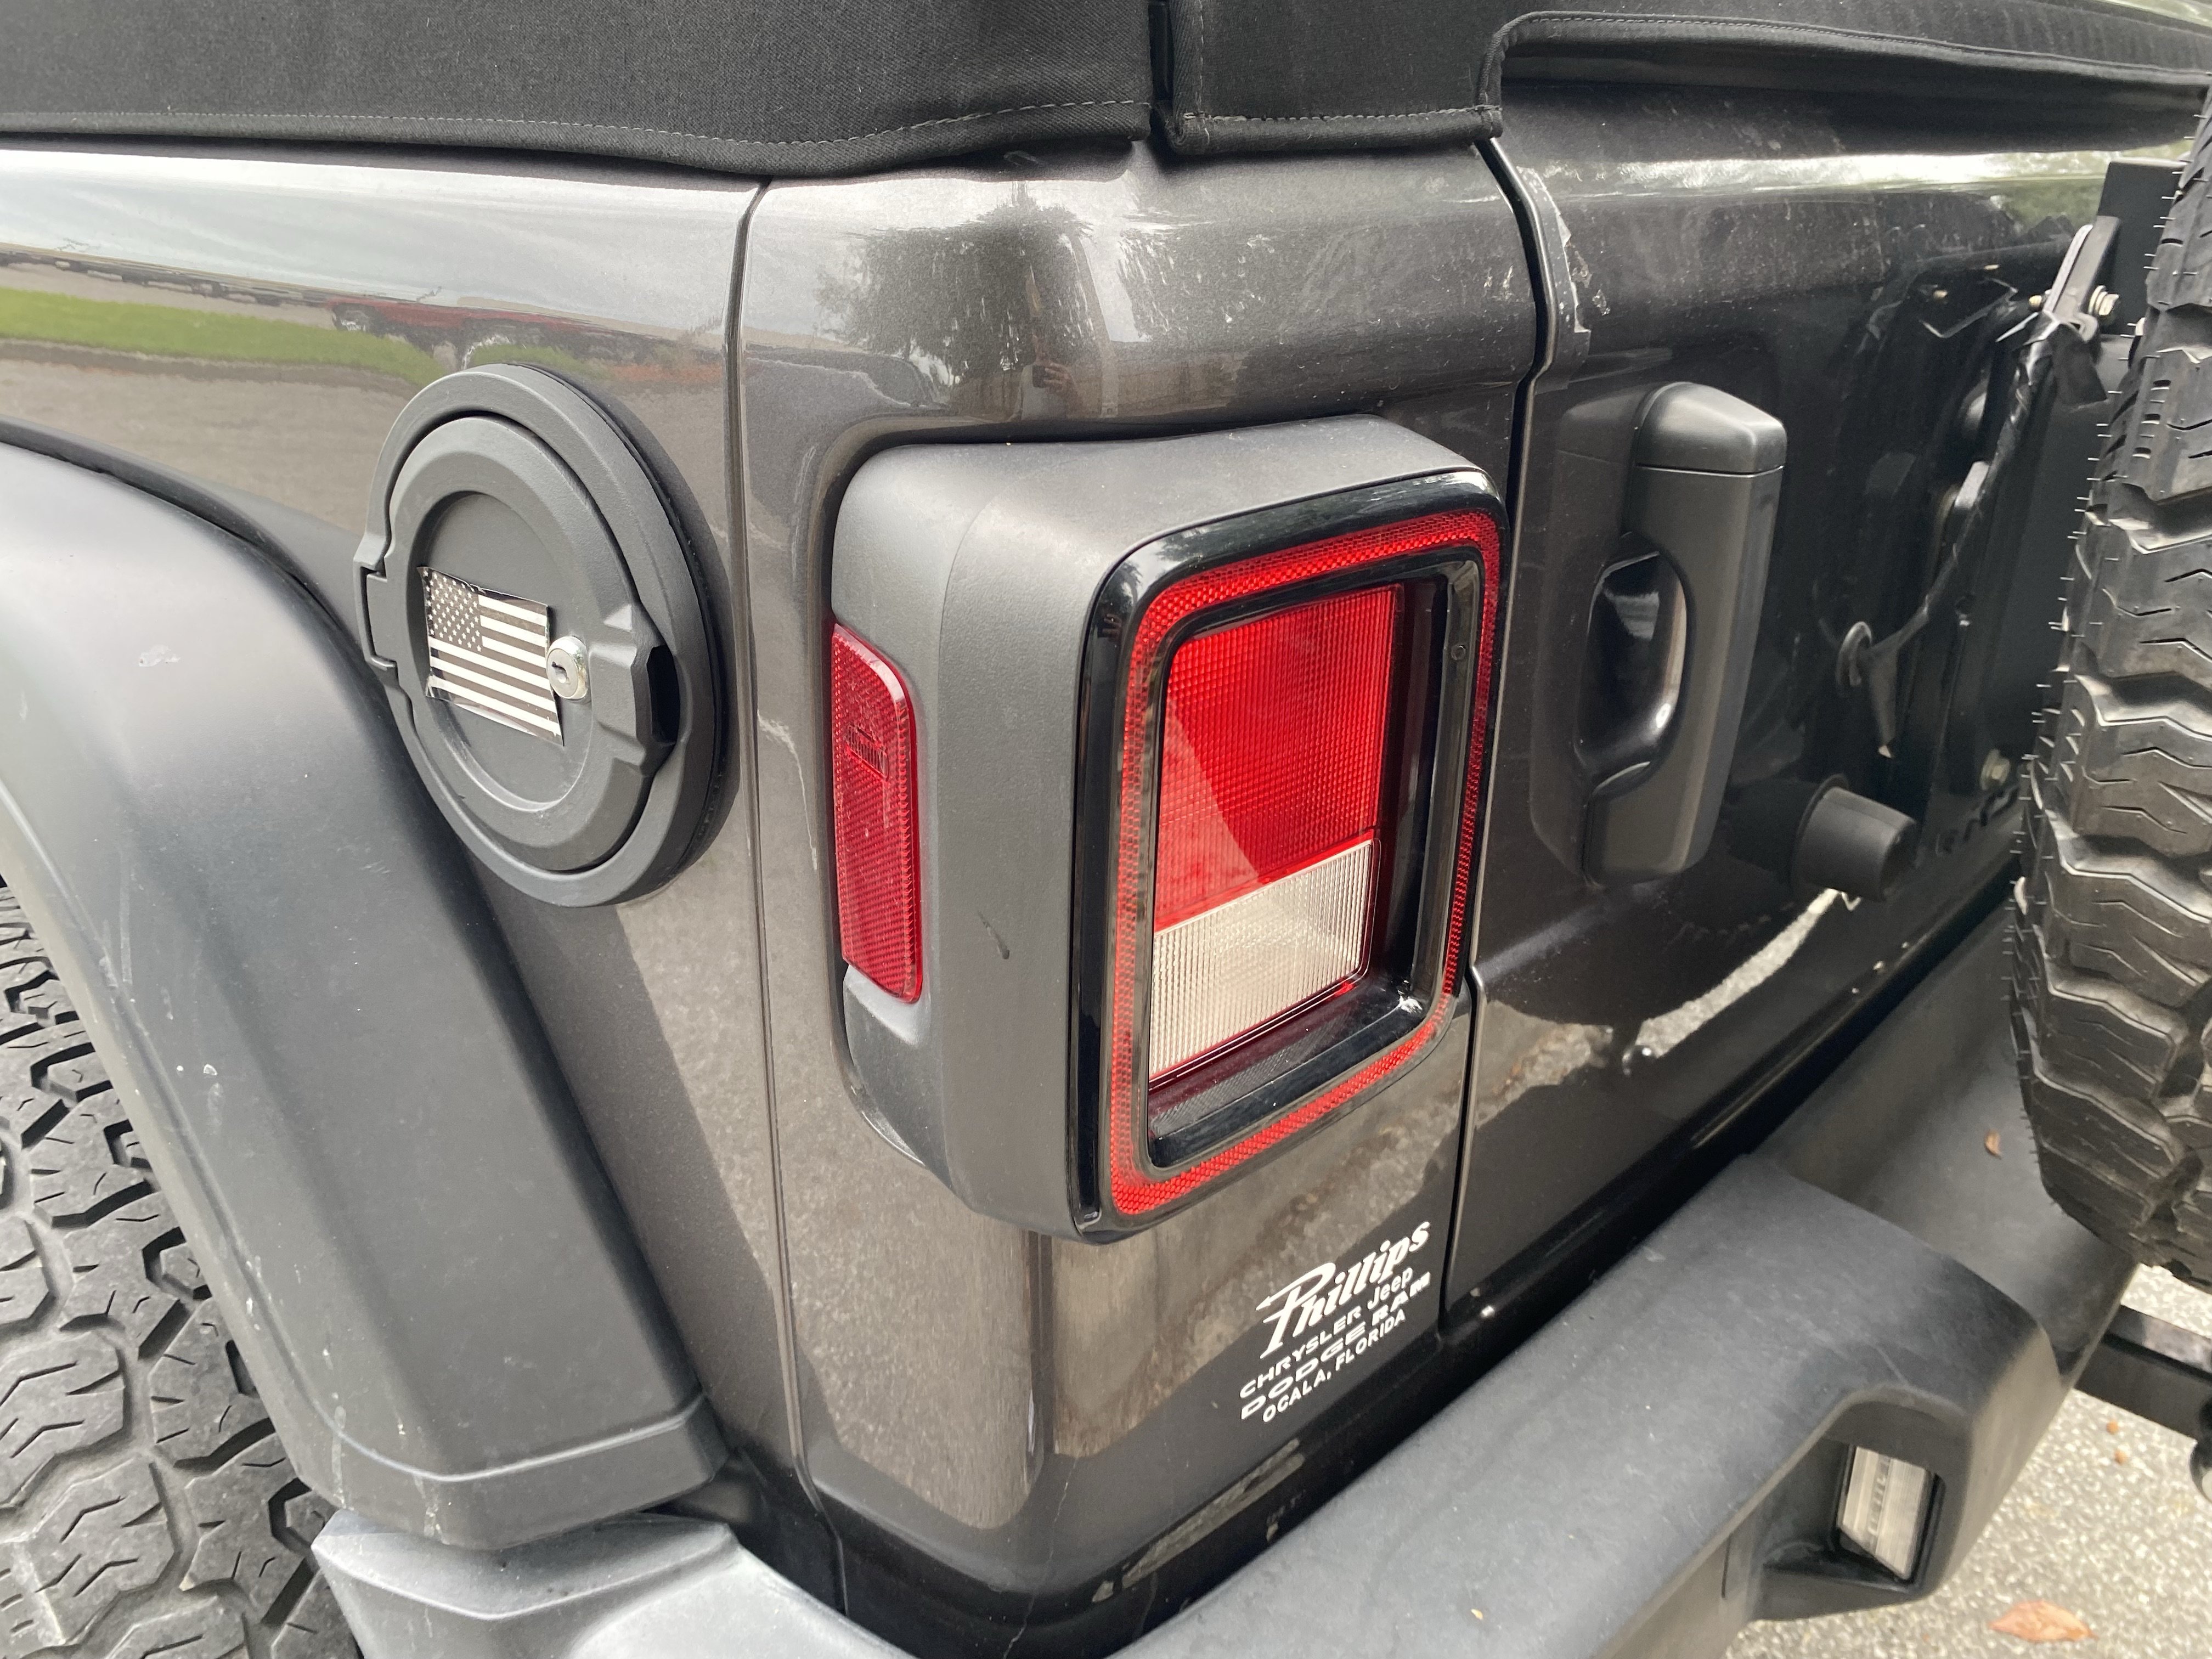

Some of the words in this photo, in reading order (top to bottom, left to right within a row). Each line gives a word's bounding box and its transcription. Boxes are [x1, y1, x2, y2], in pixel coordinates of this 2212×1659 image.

[1240, 1306, 1362, 1399] CHRYSLER
[1367, 1267, 1413, 1310] Jeep
[1241, 1321, 1367, 1420] DODGE
[1372, 1272, 1431, 1326] RAM
[1256, 1221, 1430, 1359] Phillips
[1263, 1369, 1332, 1423] OCALA,
[1335, 1309, 1406, 1371] FLORIDA
